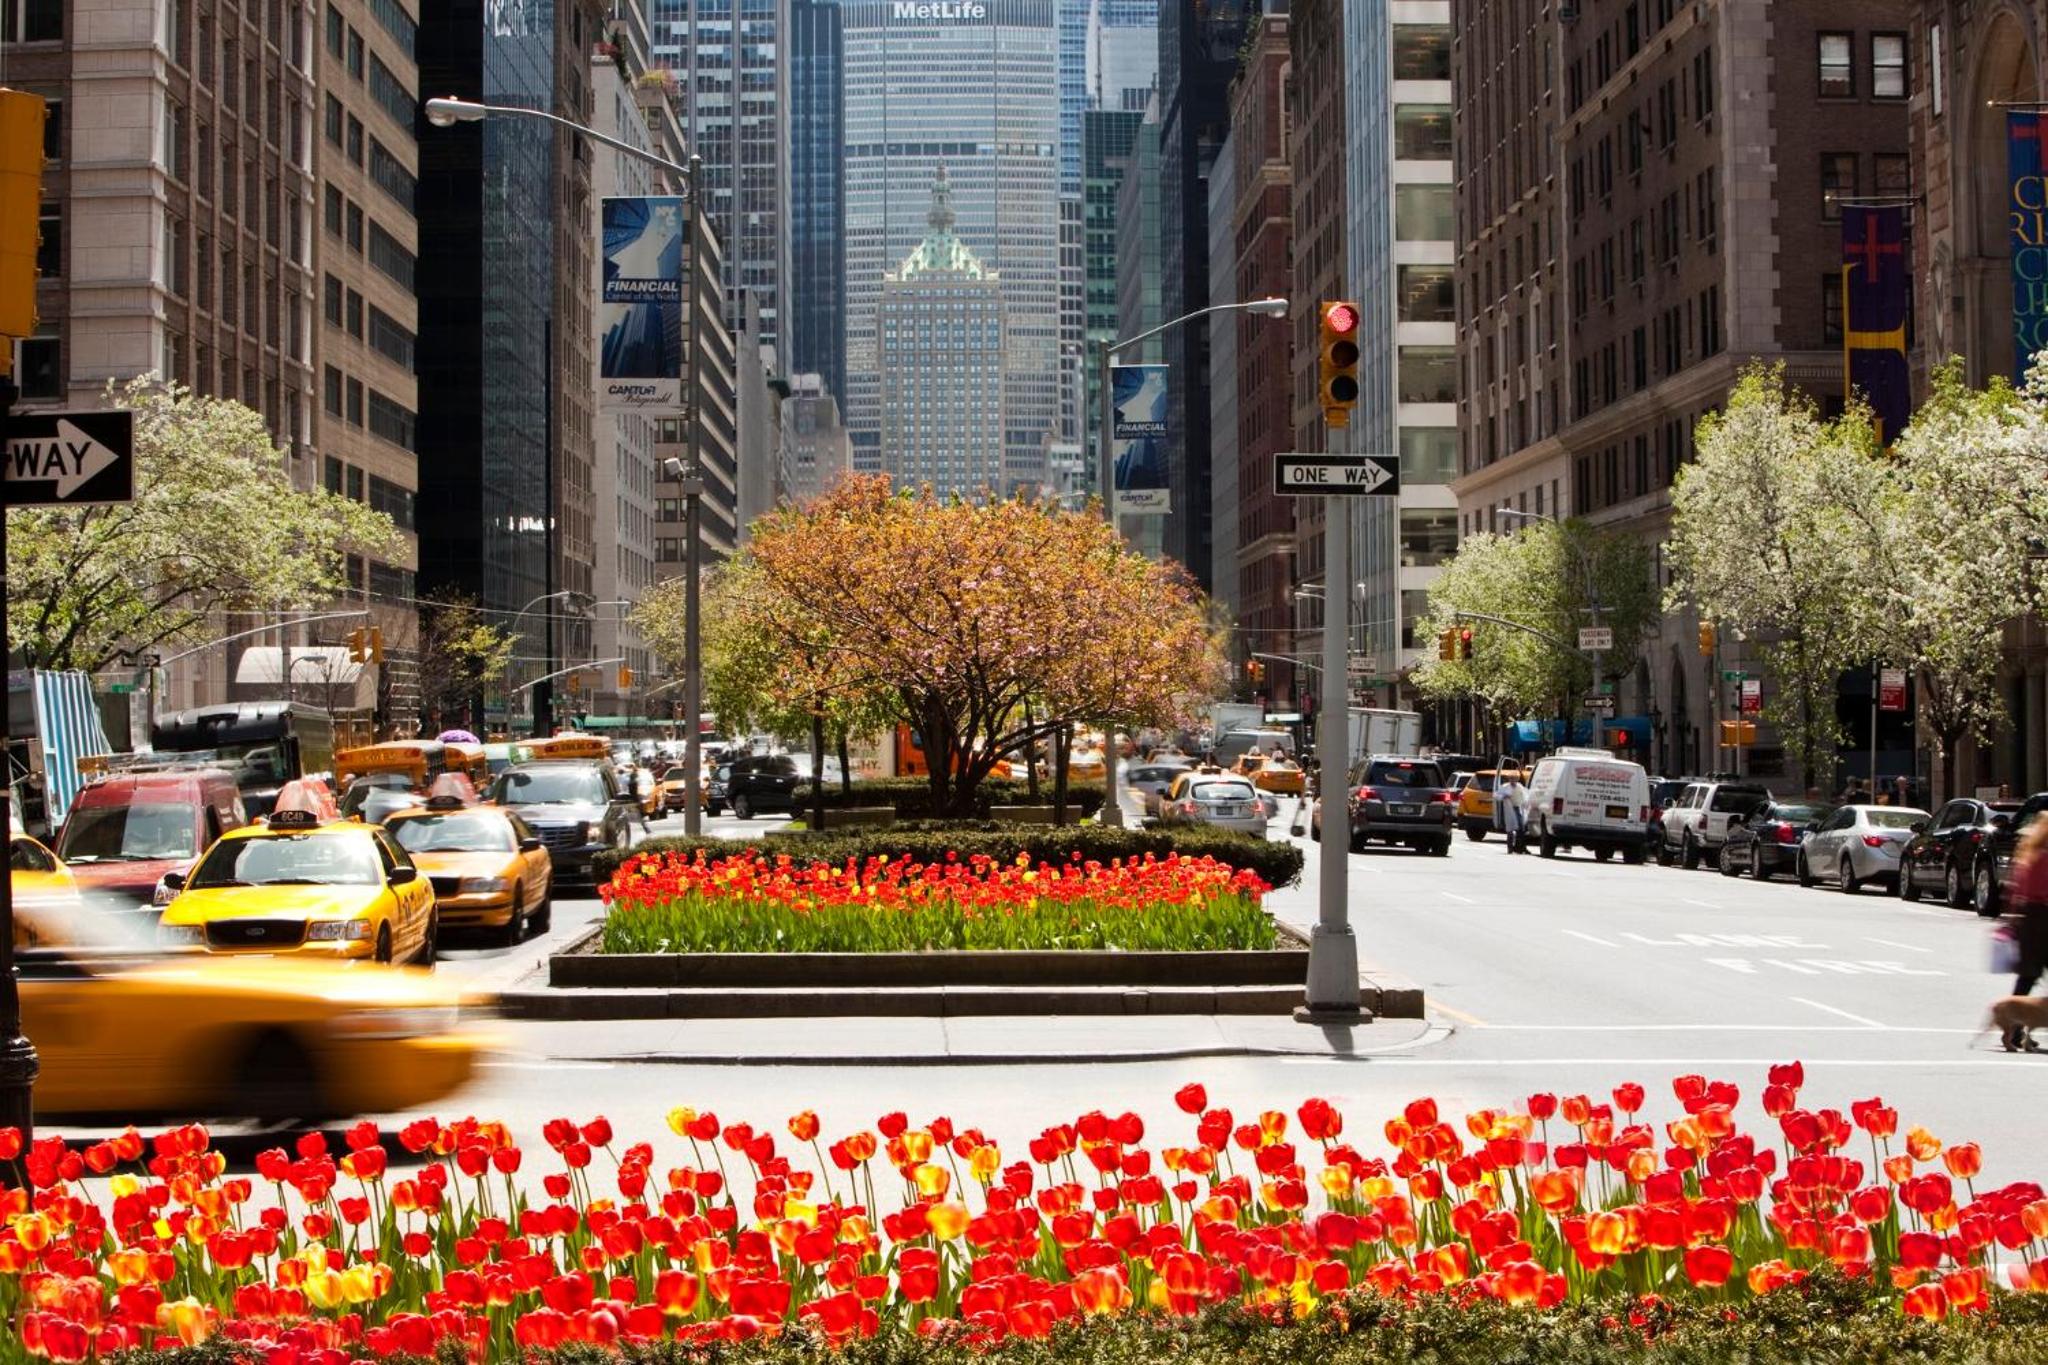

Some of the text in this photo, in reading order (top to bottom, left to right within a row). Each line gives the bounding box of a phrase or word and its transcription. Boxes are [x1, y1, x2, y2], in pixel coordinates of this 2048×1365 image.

[893, 1, 986, 19] MetLife
[606, 281, 679, 292] FINANCIAL
[608, 385, 657, 395] CANTOR
[1116, 424, 1166, 432] FINANCIAL
[13, 442, 92, 478] WAY
[1293, 467, 1381, 483] ONE WAY
